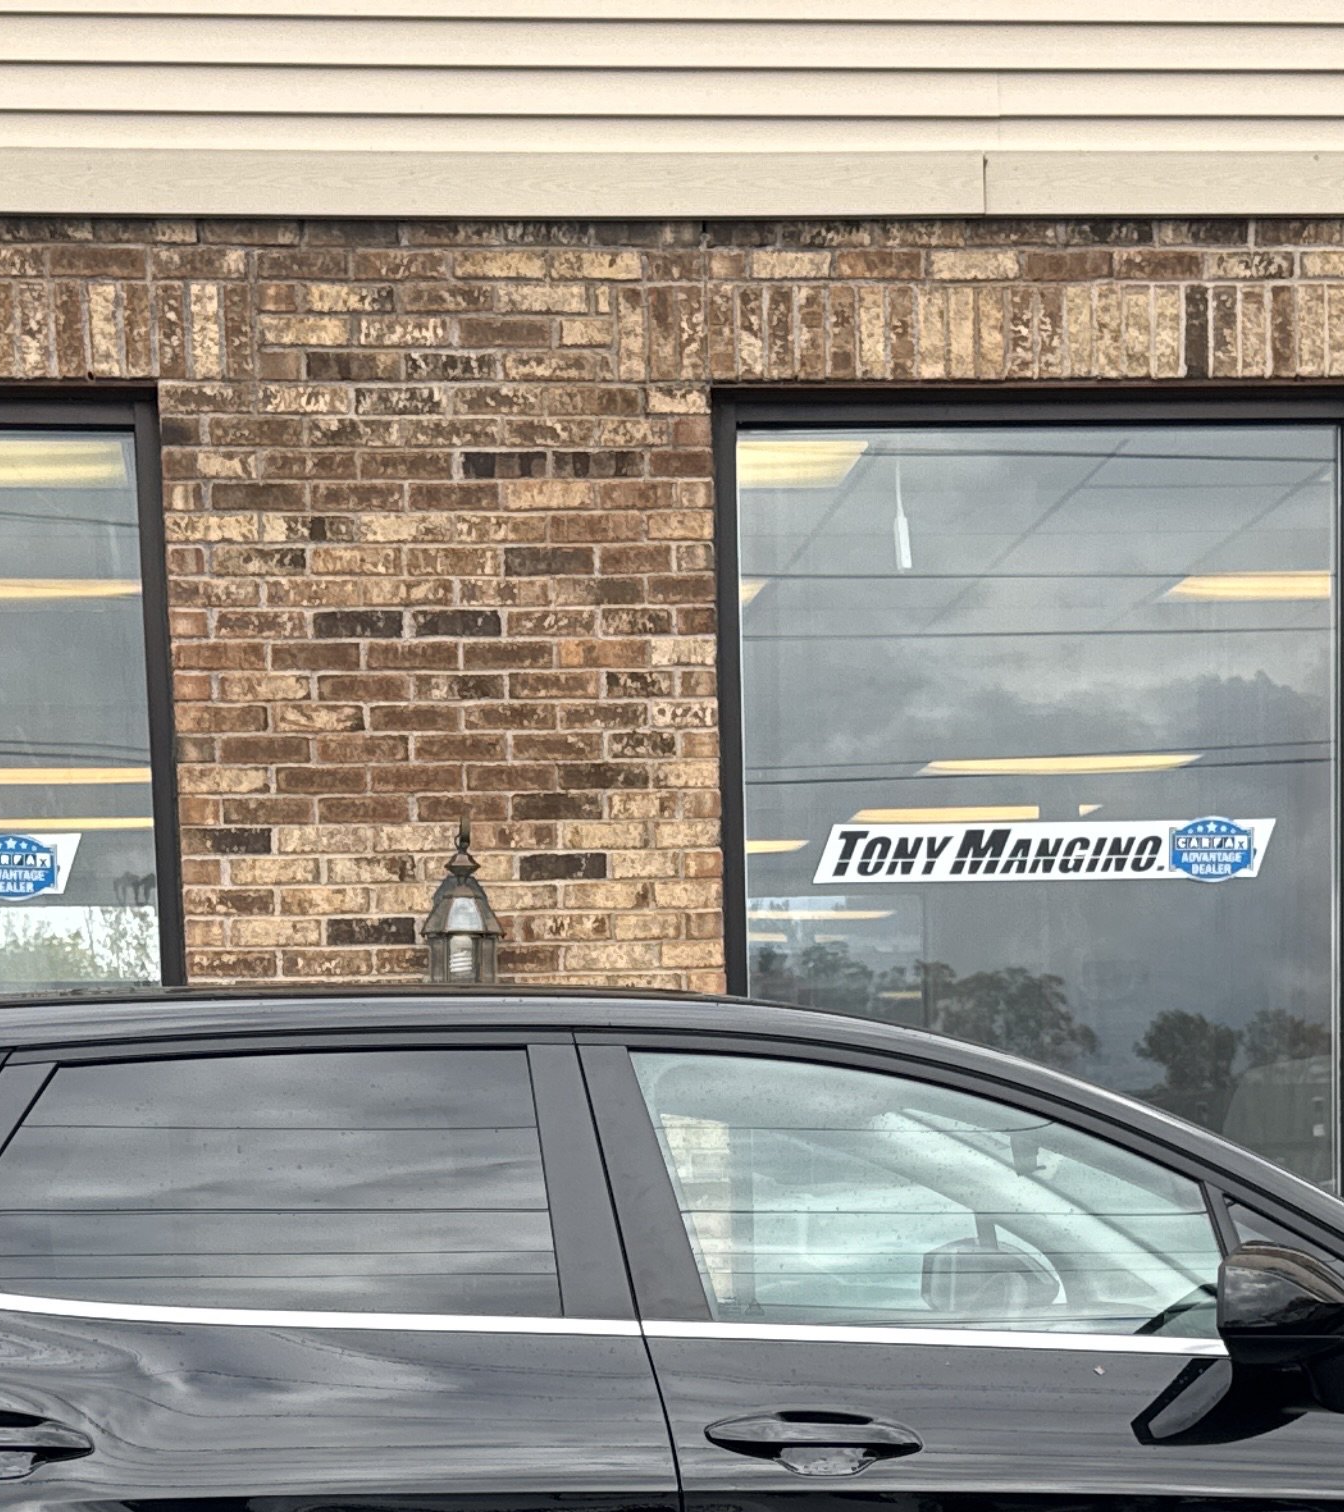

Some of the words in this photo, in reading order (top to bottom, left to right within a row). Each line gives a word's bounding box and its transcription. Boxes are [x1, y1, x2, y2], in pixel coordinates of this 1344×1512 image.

[1175, 836, 1248, 850] CARFAX
[1181, 851, 1243, 863] ADVANTAGE
[1191, 863, 1232, 875] DEALER
